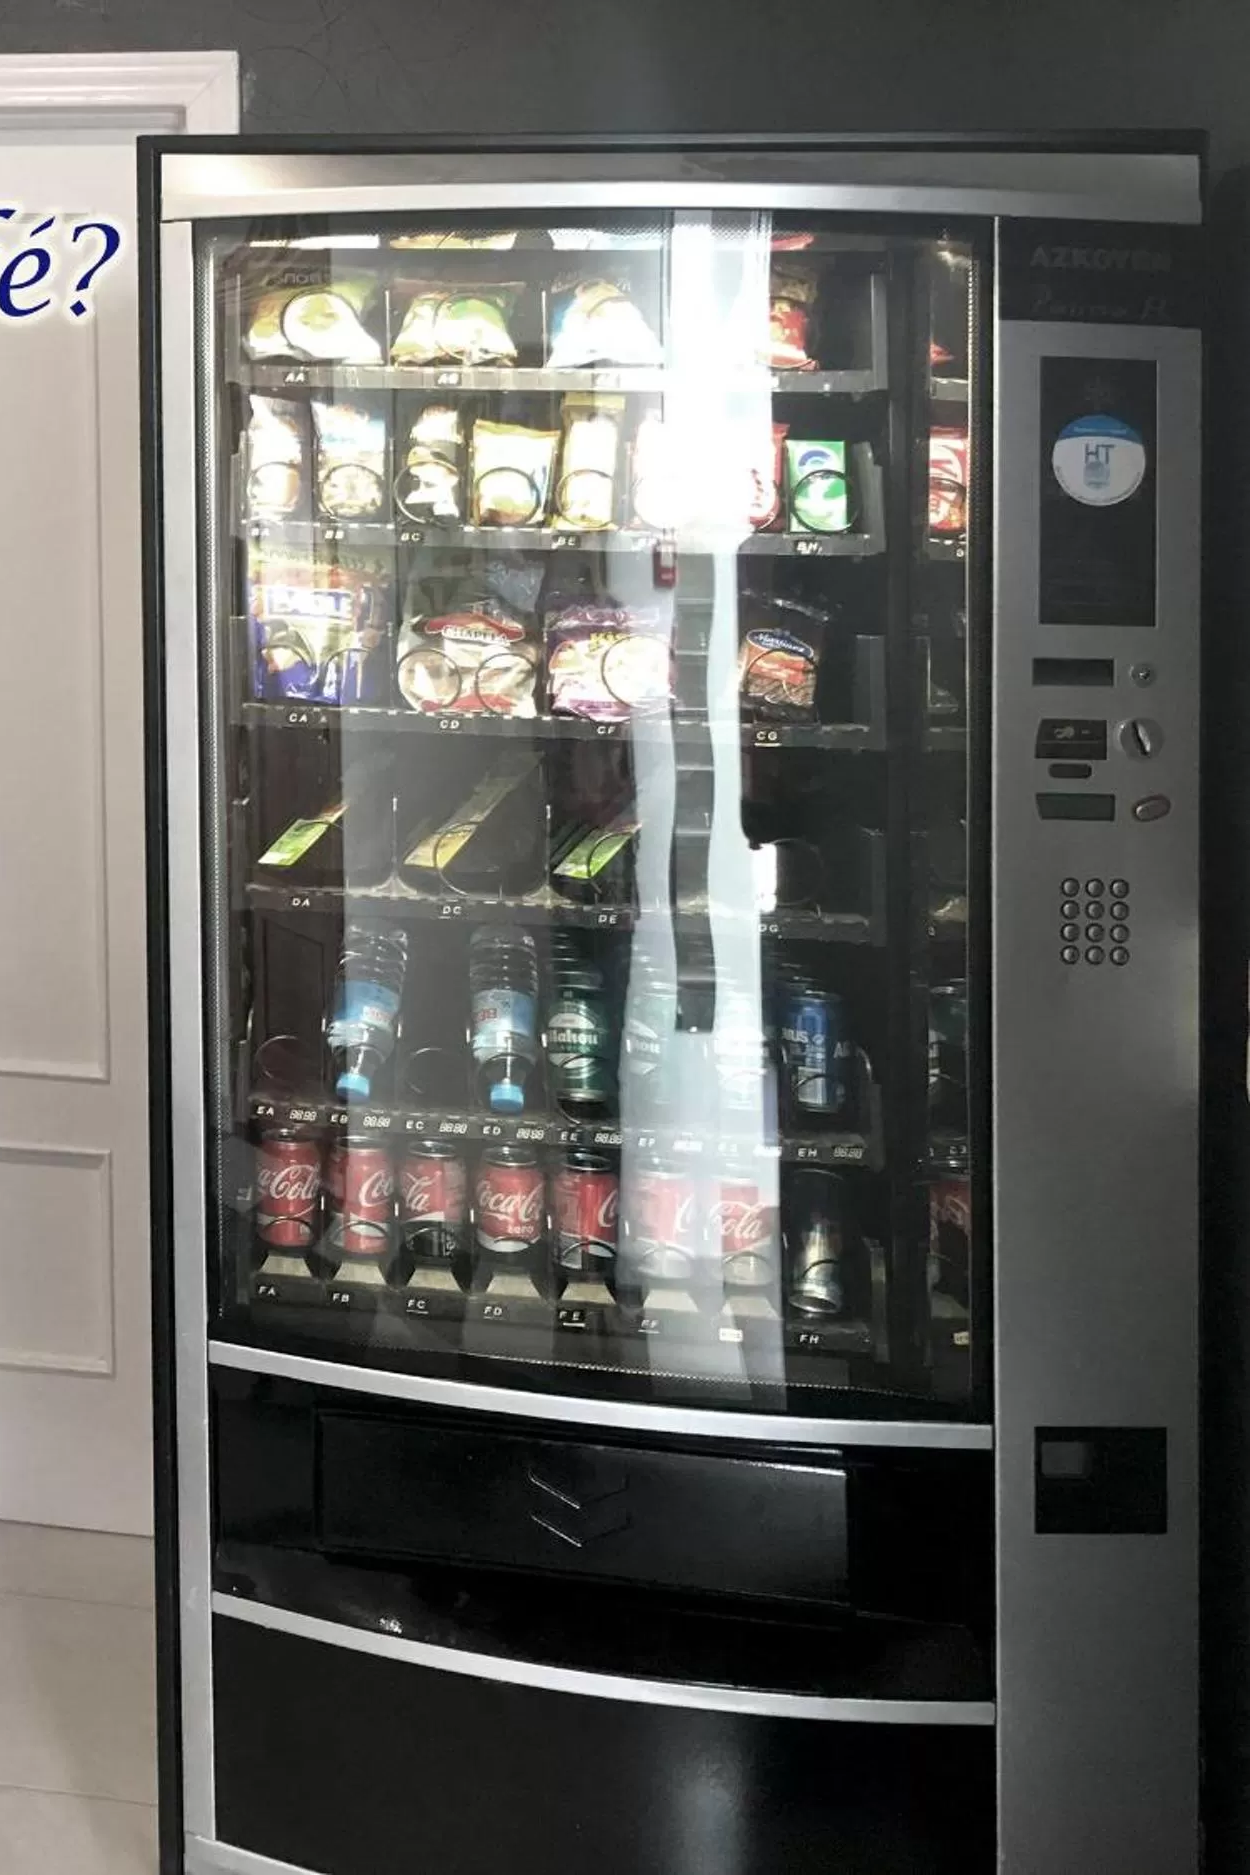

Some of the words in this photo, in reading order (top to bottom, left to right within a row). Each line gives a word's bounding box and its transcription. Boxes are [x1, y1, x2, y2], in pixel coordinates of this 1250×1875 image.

[1084, 443, 1115, 464] HT
[288, 713, 308, 723] CA
[439, 719, 460, 729] CD
[292, 897, 310, 907] DA
[442, 905, 462, 915] DC
[405, 1120, 425, 1130] EC
[258, 1285, 276, 1297] FA
[407, 1299, 426, 1309] FC
